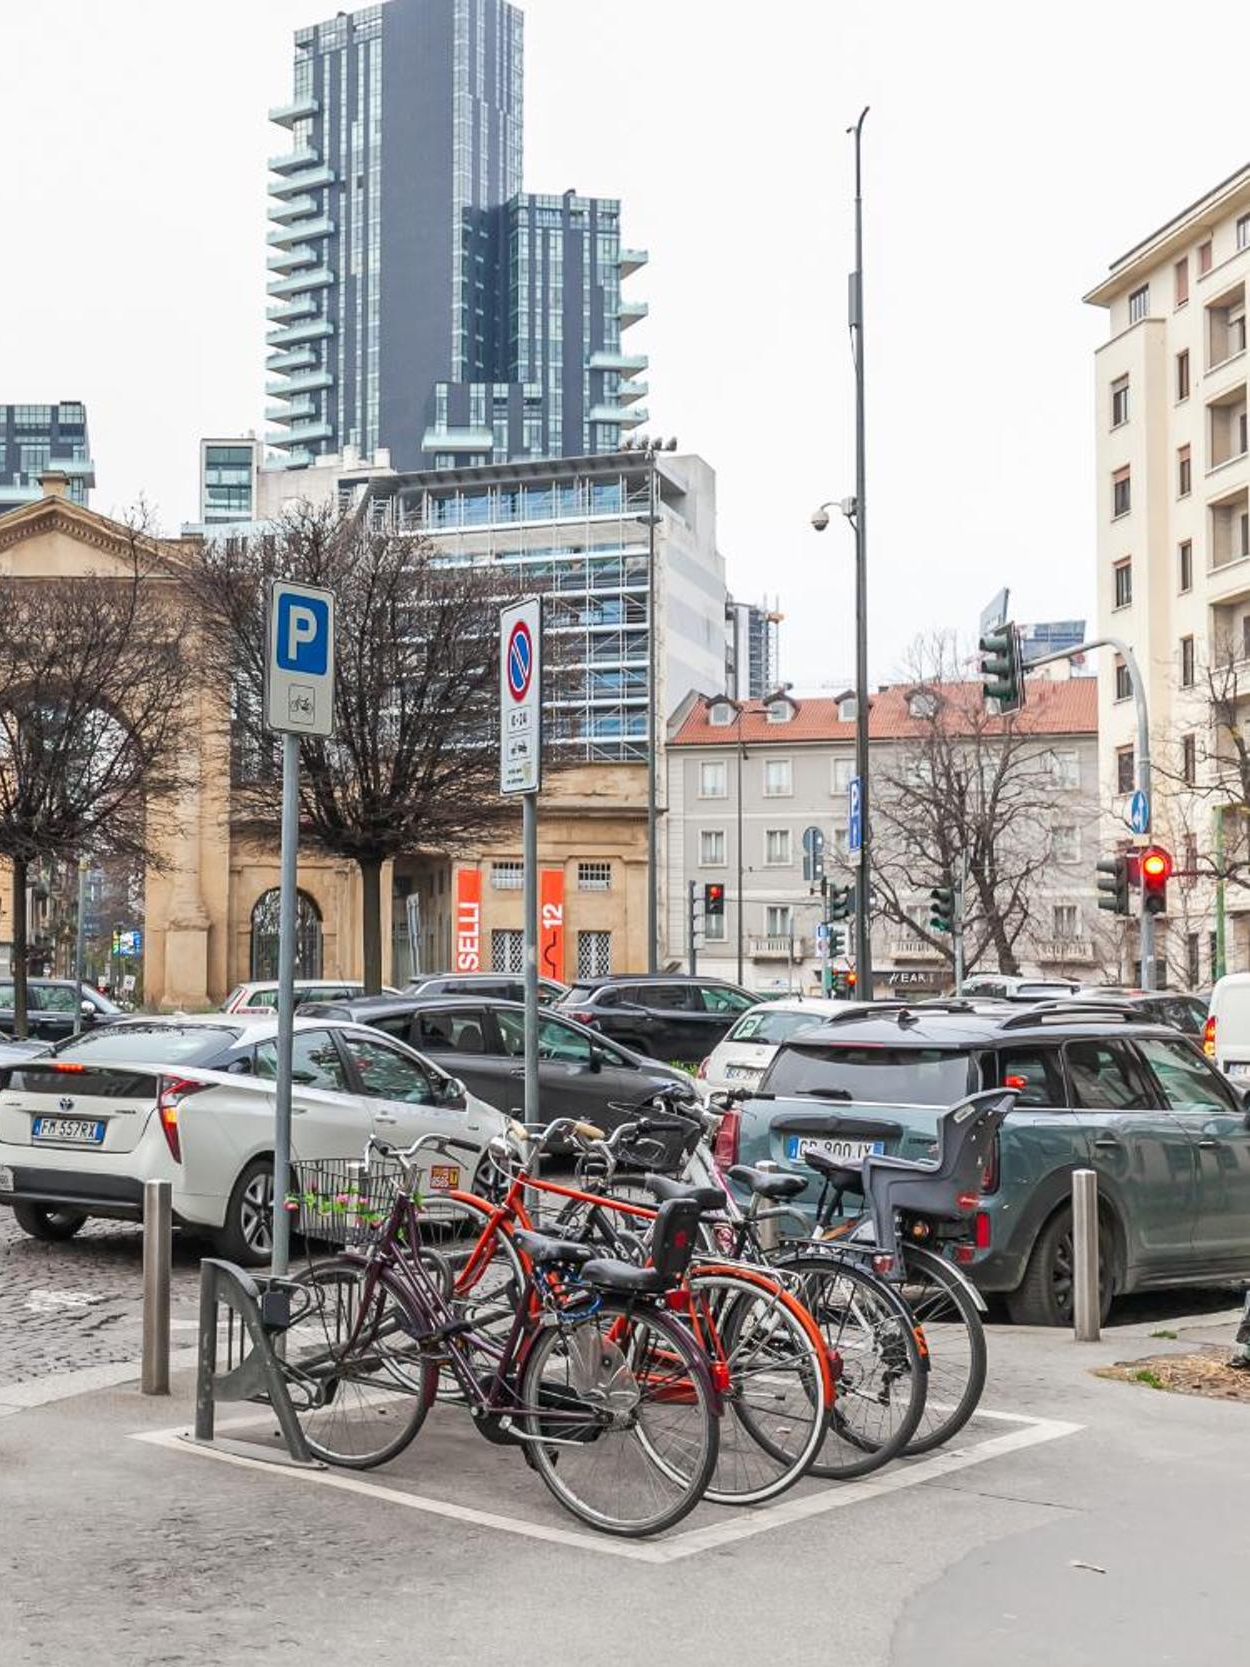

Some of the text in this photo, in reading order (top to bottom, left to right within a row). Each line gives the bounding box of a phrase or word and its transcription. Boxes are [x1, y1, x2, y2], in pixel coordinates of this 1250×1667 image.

[288, 604, 318, 661] P
[458, 902, 479, 971] SELLI
[542, 903, 563, 929] 12
[59, 1121, 96, 1138] 557RX
